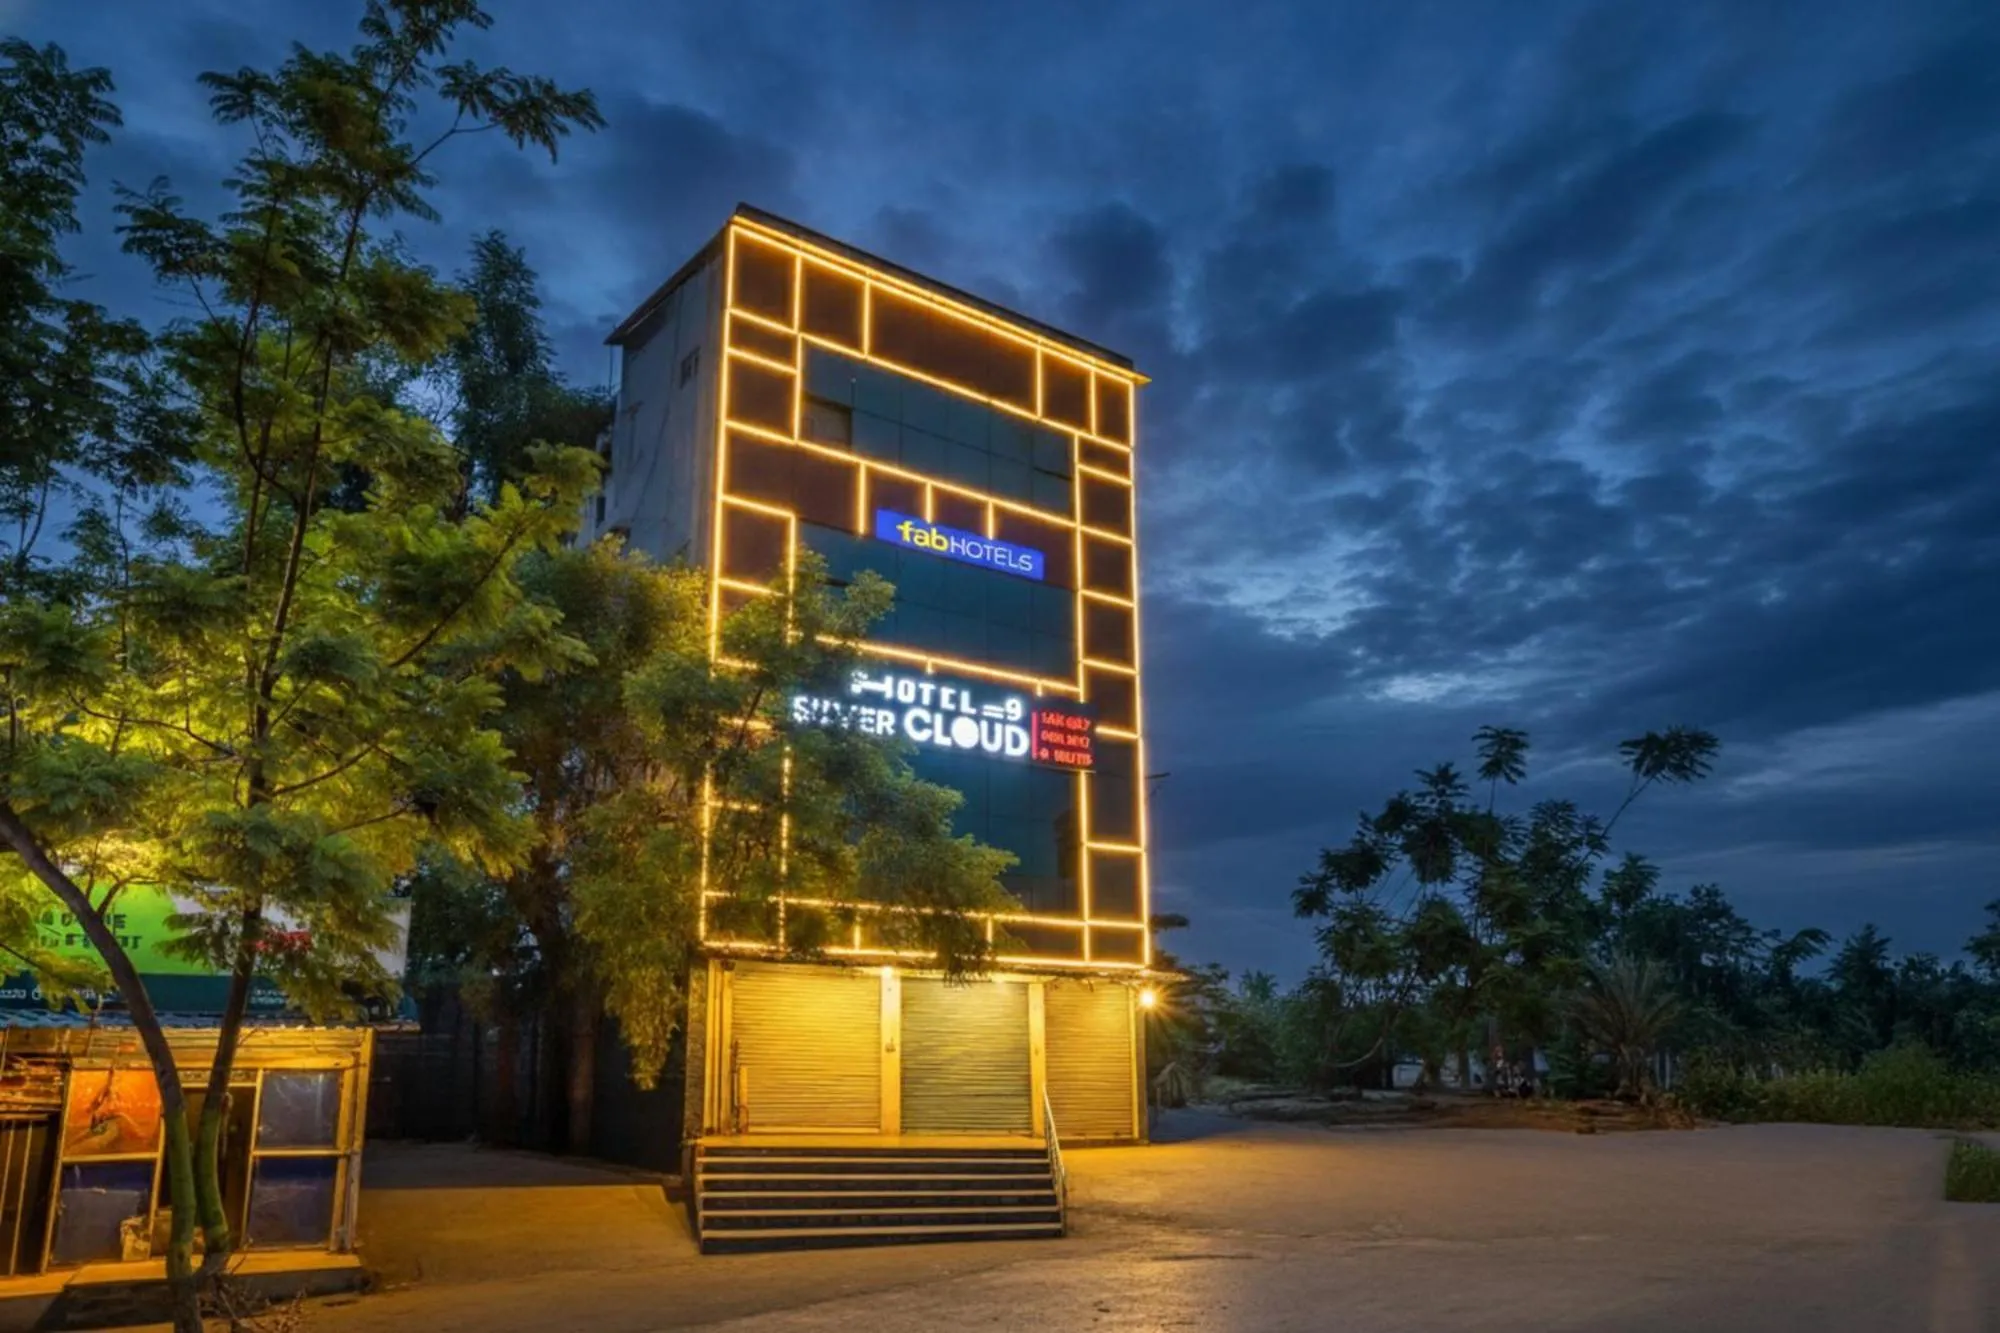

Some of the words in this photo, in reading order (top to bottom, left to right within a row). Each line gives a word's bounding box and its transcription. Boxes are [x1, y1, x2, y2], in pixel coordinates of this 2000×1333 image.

[896, 520, 1033, 572] fabHOTELS
[850, 671, 977, 715] HOTEL
[903, 707, 1030, 756] CLOUD
